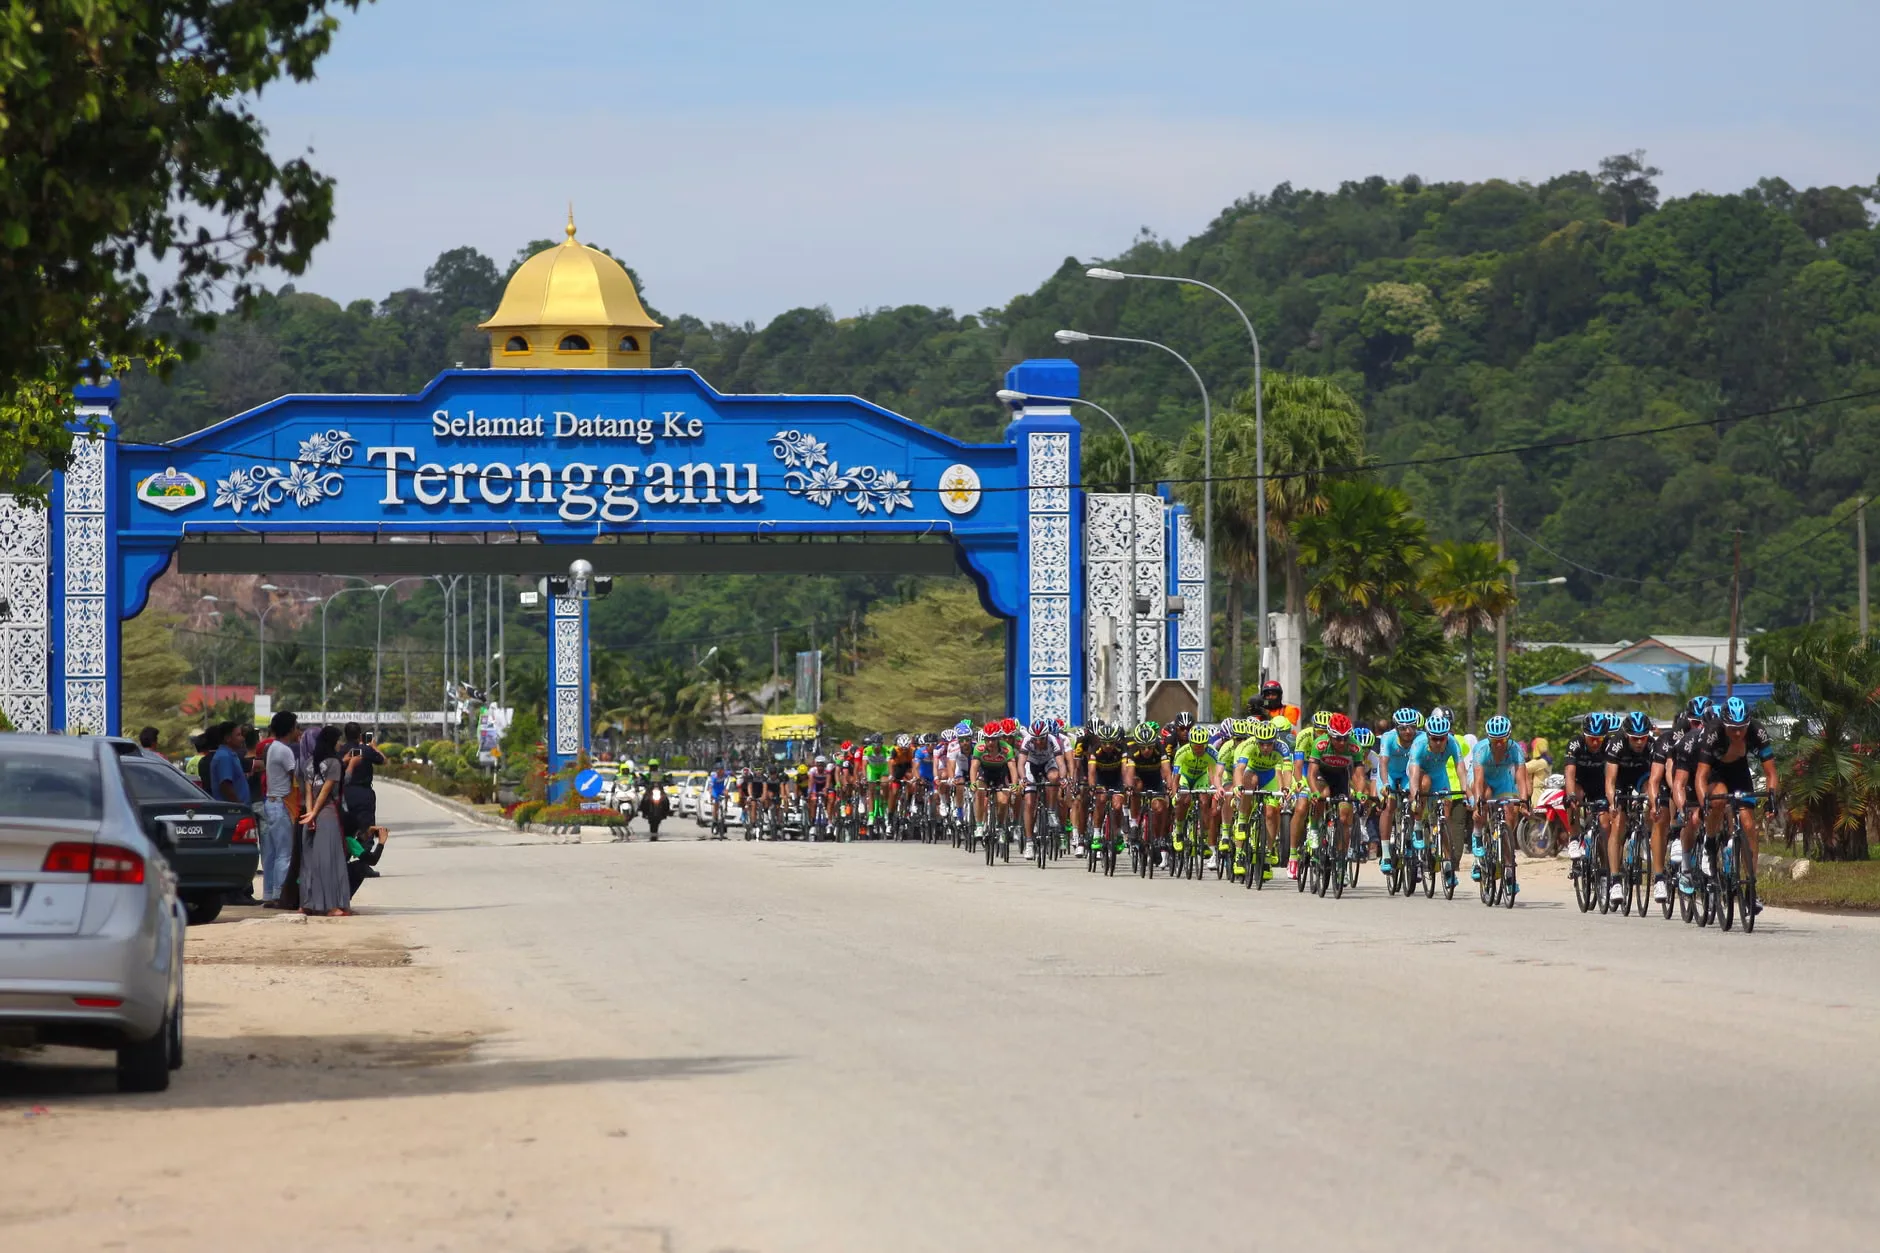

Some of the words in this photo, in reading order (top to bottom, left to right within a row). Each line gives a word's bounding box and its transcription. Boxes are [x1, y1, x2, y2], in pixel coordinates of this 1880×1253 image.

[432, 410, 545, 438] Selamat
[553, 411, 654, 445] Datang
[662, 411, 703, 437] Ke
[366, 446, 764, 522] Terengganu
